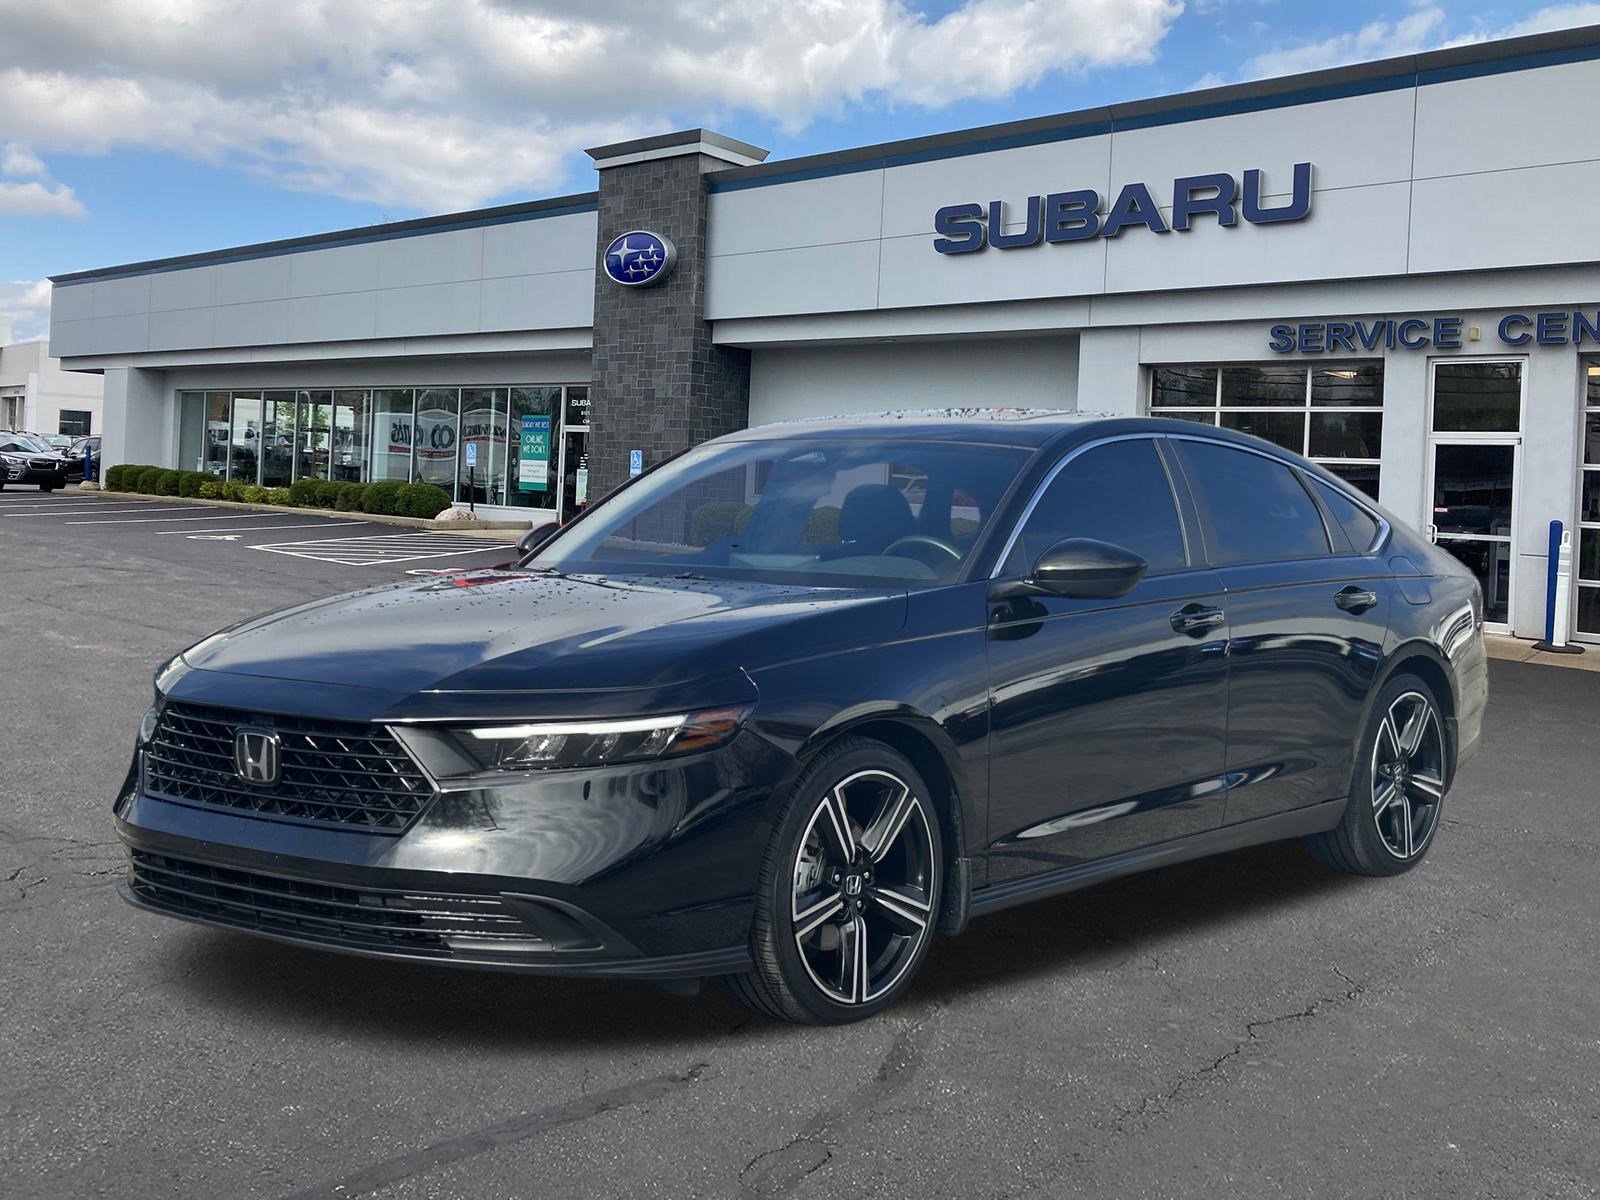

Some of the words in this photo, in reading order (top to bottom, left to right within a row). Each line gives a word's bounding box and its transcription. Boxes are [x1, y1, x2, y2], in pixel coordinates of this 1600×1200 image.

[933, 161, 1315, 255] SUBARU
[1268, 317, 1464, 353] SERVICE
[1497, 311, 1600, 346] CEN
